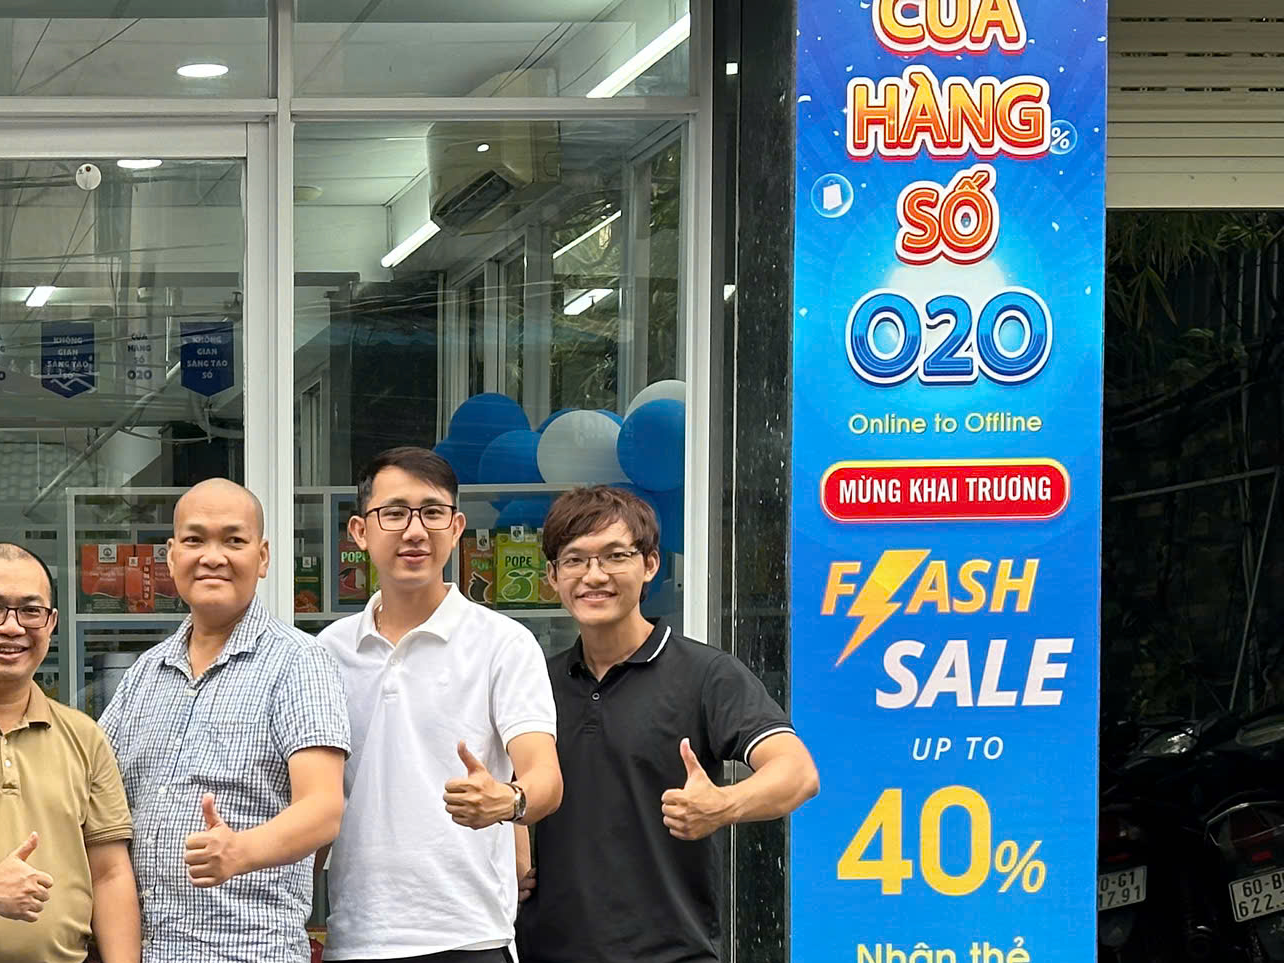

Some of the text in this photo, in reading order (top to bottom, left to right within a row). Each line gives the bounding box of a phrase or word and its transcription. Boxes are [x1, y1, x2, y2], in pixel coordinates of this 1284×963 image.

[850, 69, 1047, 150] HÀNG
[900, 168, 995, 256] SỐ
[849, 411, 1042, 434] Online to Offline
[838, 474, 1052, 504] MỪNG KHAI TRƯƠNG
[505, 555, 532, 567] POPE
[875, 637, 1075, 709] SALE
[912, 736, 1004, 761] UP TO
[836, 785, 1046, 897] 40%
